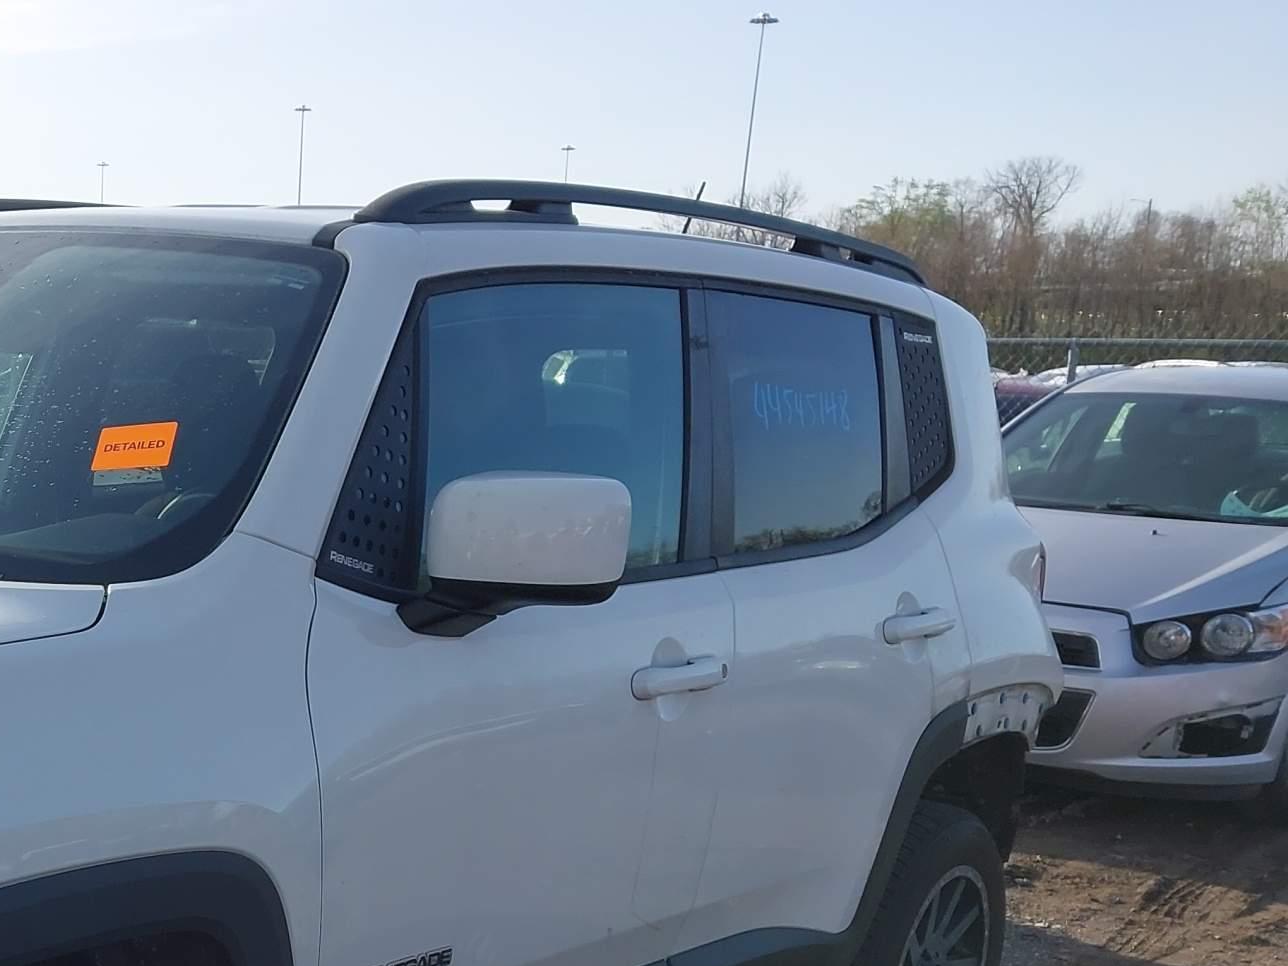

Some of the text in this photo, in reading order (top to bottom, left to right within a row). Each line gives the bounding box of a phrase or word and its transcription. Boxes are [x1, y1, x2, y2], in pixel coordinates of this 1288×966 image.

[754, 383, 851, 431] 44545148
[103, 439, 166, 453] DETAILED
[329, 550, 375, 574] RENEGADE
